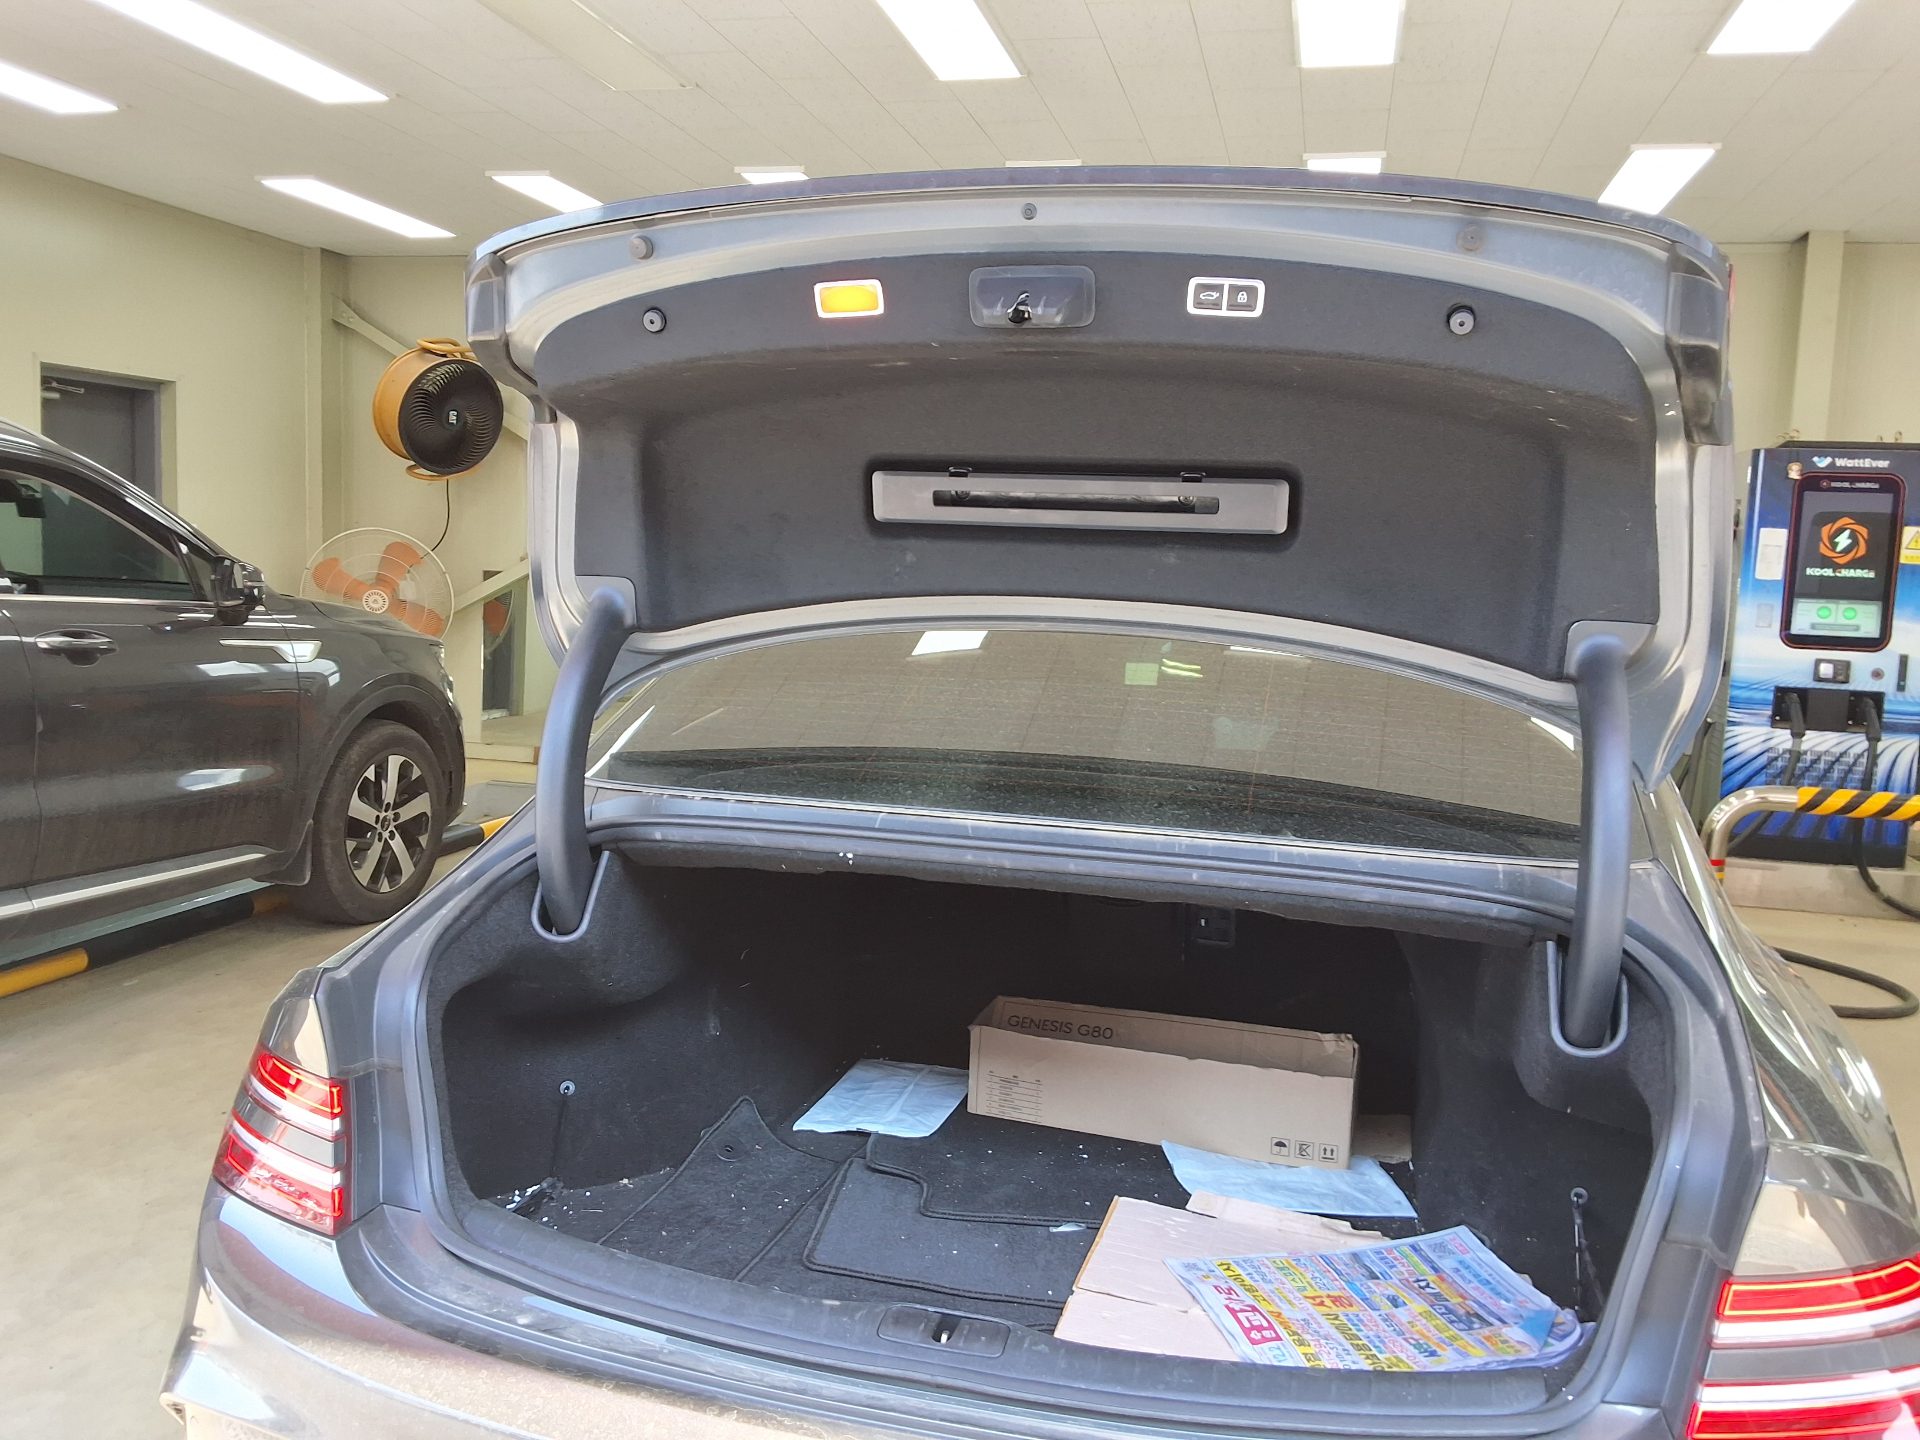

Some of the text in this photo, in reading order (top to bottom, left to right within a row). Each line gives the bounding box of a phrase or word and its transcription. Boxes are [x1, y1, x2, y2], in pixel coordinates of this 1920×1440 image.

[1834, 457, 1890, 468] WattEver
[1007, 1015, 1113, 1039] GENESIS G80
[1215, 1262, 1272, 1306] 고향이사
[1212, 1285, 1270, 1328] 교차로
